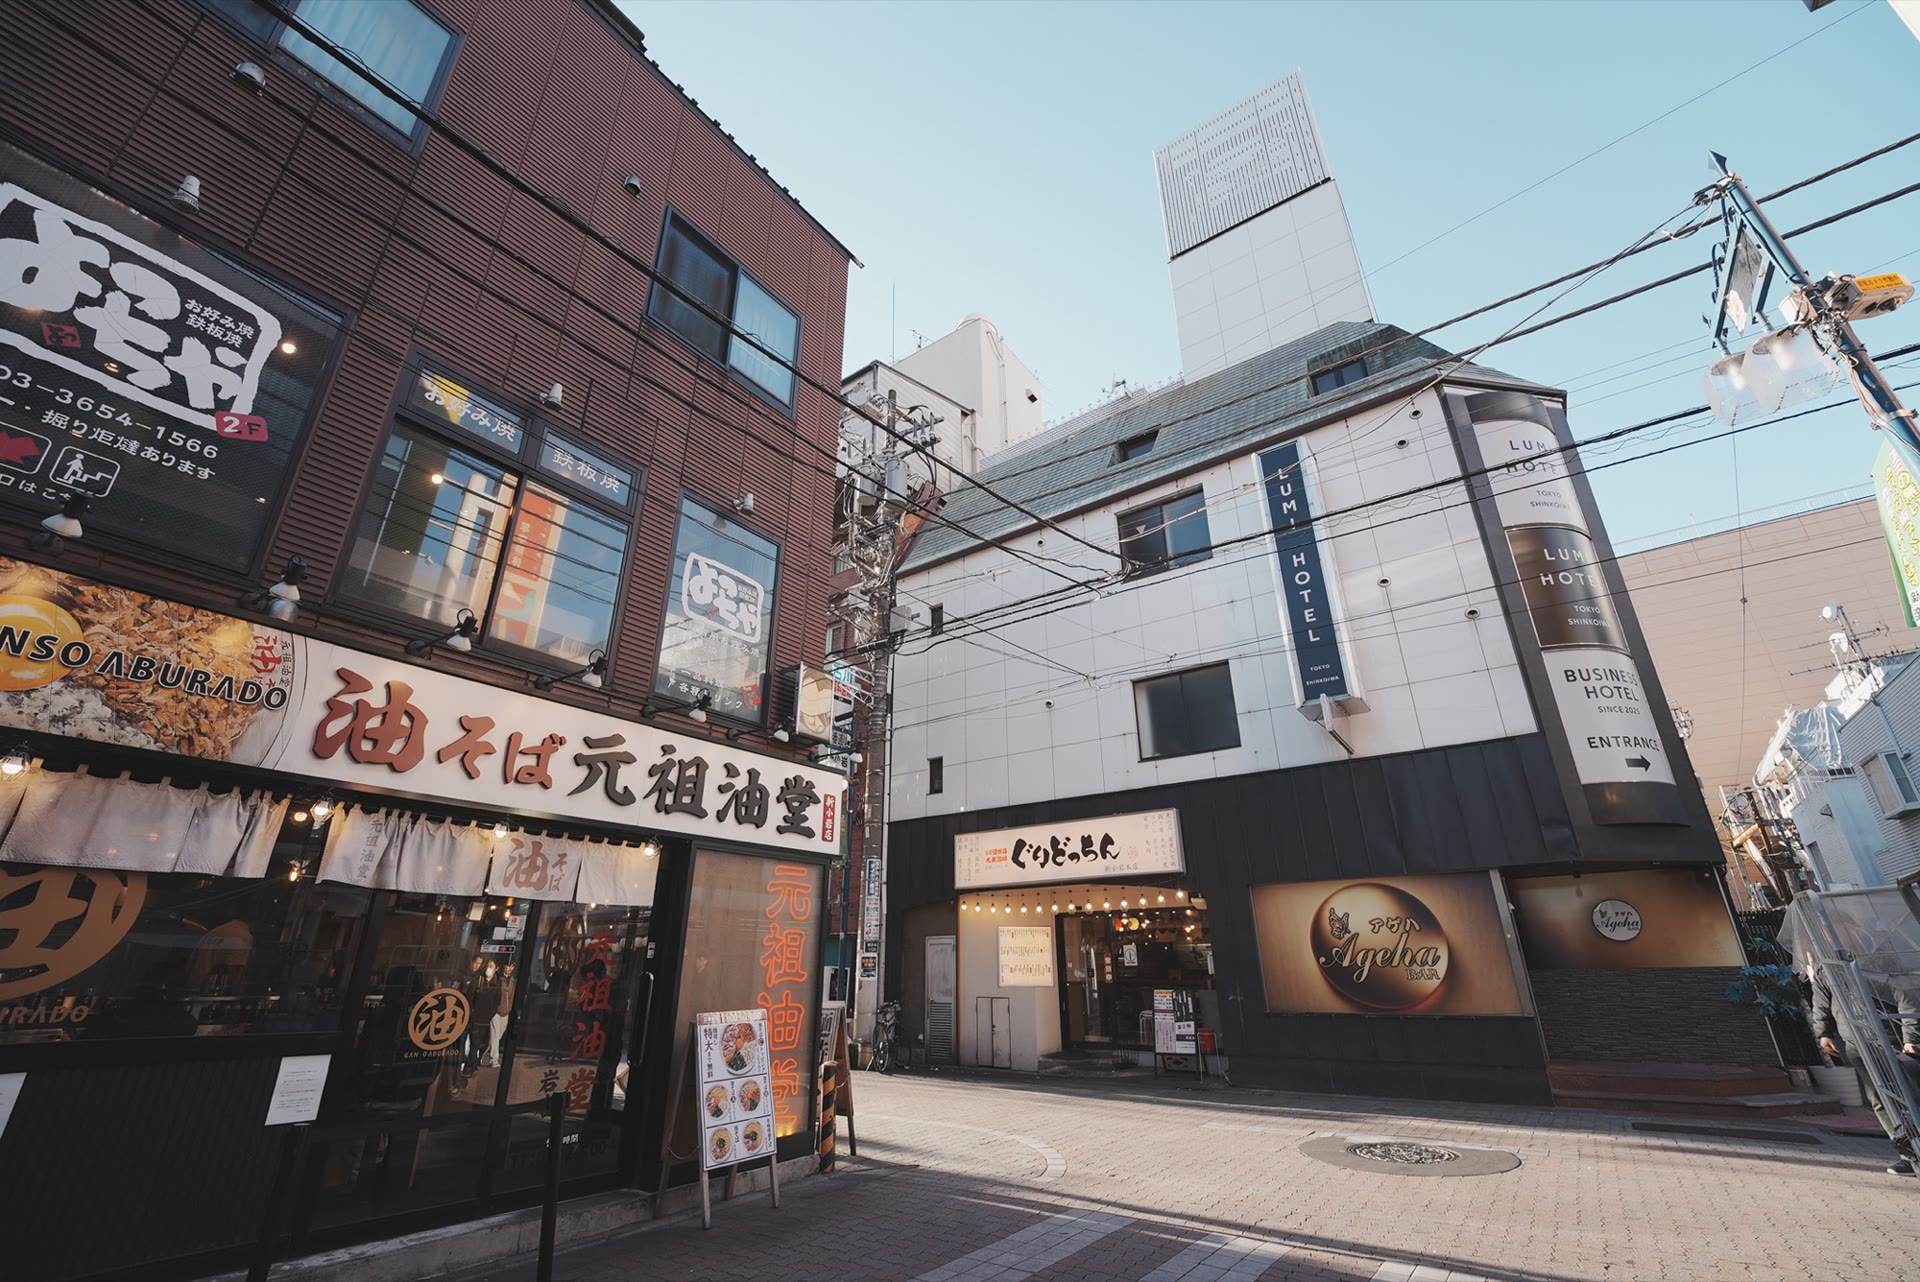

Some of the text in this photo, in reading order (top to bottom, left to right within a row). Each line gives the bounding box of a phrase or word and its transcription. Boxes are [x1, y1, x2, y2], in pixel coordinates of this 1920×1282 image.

[184, 298, 256, 340] お好み焼
[185, 313, 243, 348] 鉄板焼
[222, 416, 261, 436] 2F
[425, 385, 516, 443] お好み焼
[552, 446, 620, 494] 鉄板焼
[1293, 554, 1320, 642] HOTEL
[1573, 605, 1601, 614] TOKYO
[94, 650, 289, 711] ABURADO
[1306, 675, 1340, 686] SHINKOIWA
[1310, 663, 1331, 672] TOKYO
[1564, 667, 1638, 686] BUSINESS
[1584, 685, 1639, 702] HOTEL
[1597, 705, 1624, 714] SINCE
[313, 666, 822, 840] 油そば 元祖油堂
[1587, 736, 1661, 752] ENTRANCE
[825, 795, 835, 840] 新小岩店
[1368, 917, 1421, 934] アゲハ
[1597, 916, 1639, 933] Ageha
[1319, 932, 1440, 983] Ageha
[1405, 967, 1441, 981] BAR
[757, 864, 813, 1123] 元祖油堂
[412, 996, 464, 1042] 油
[565, 930, 620, 1113] 元祖油堂
